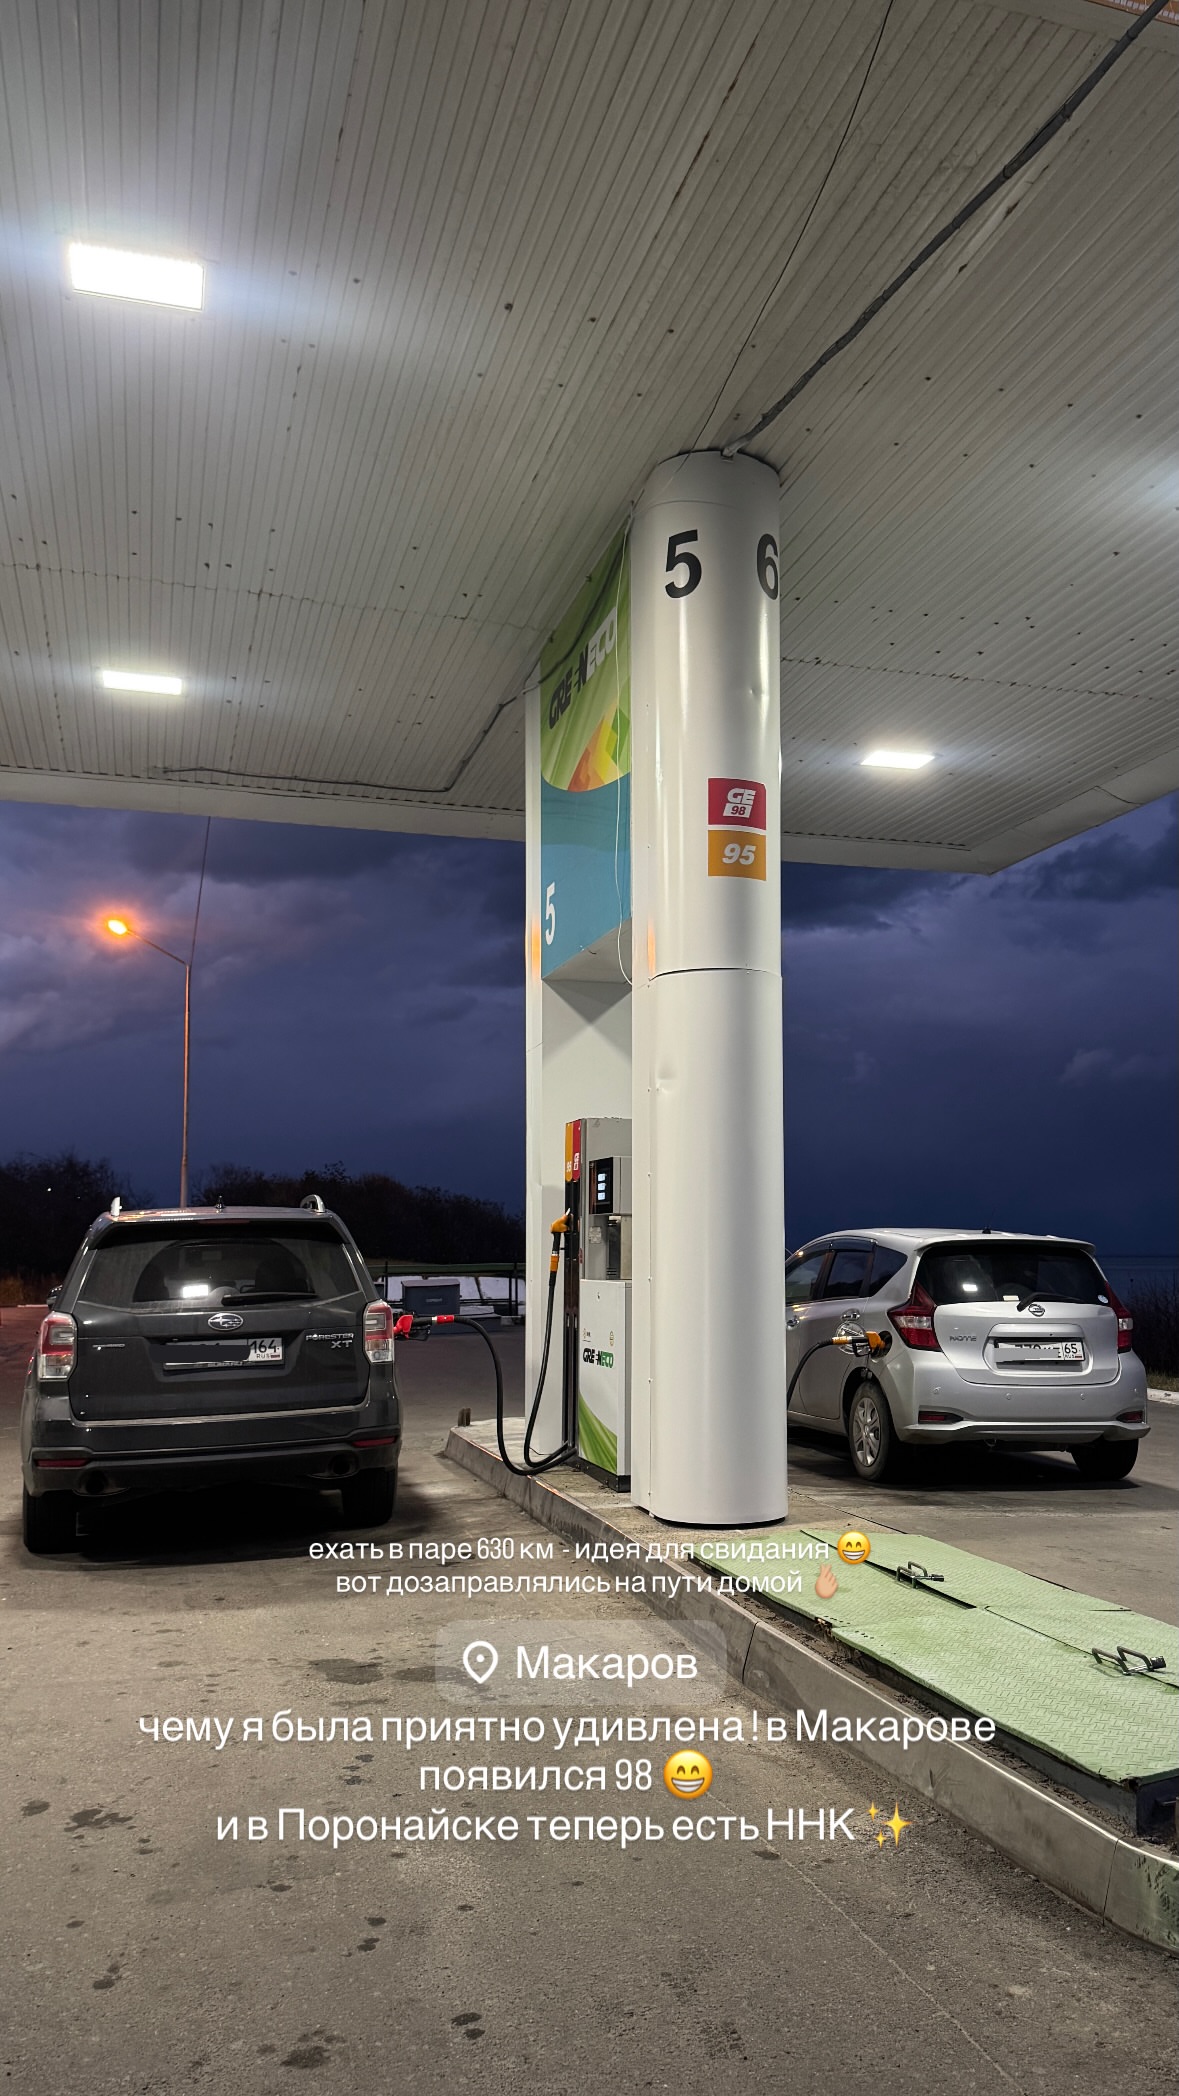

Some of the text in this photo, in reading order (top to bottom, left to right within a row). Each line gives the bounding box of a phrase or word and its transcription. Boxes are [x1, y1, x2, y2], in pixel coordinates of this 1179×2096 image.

[665, 529, 702, 598] 5
[756, 533, 780, 600] 6
[727, 787, 757, 806] GE
[731, 805, 747, 816] 98
[722, 843, 757, 865] 95
[545, 881, 556, 946] 5
[249, 1340, 277, 1354] 164
[331, 1340, 353, 1349] XT
[1064, 1343, 1078, 1354] 65
